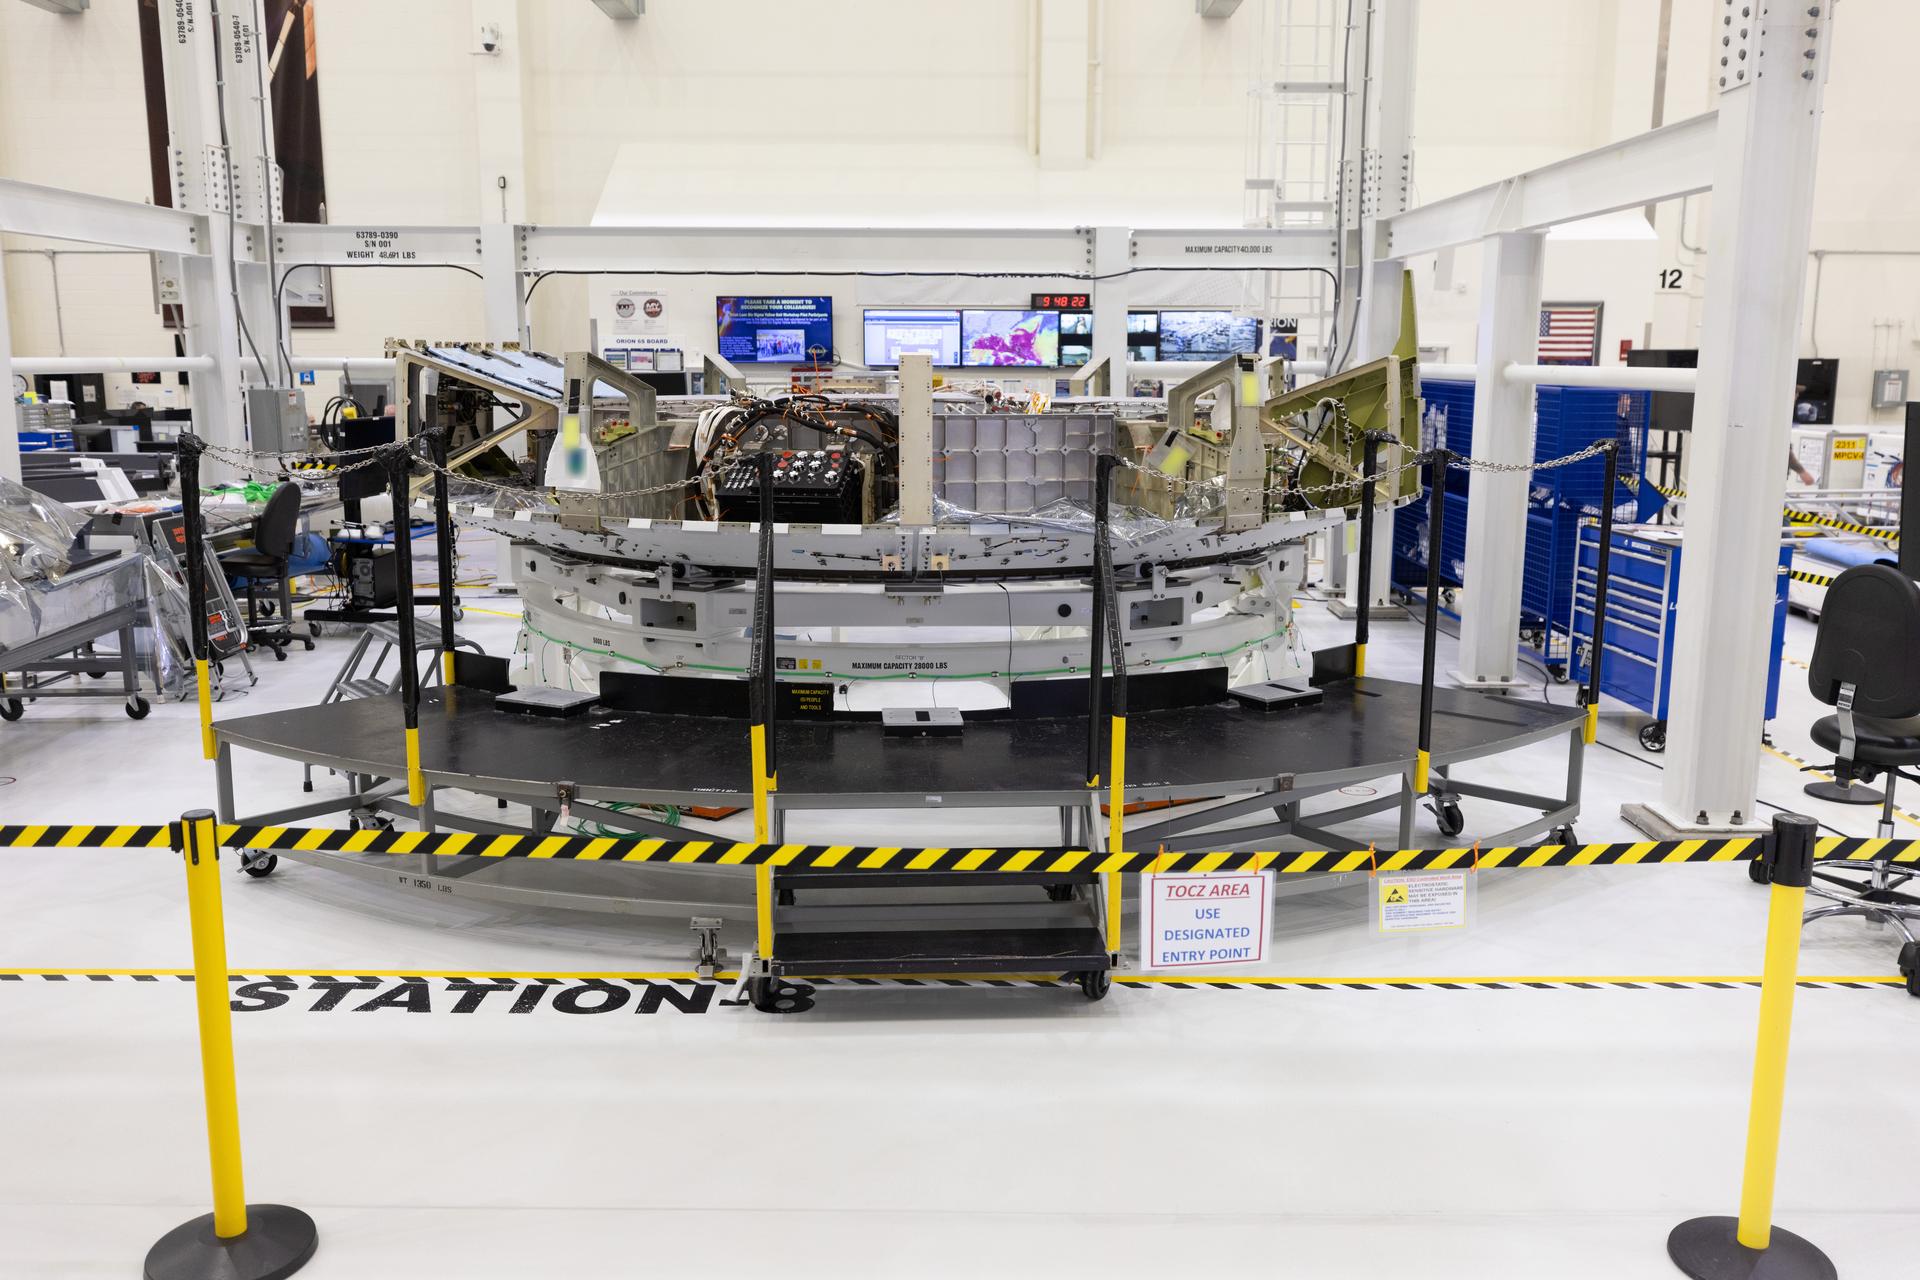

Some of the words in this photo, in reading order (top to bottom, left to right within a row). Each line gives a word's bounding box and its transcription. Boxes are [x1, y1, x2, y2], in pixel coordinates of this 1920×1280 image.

[356, 231, 399, 239] 63789-0390
[364, 240, 376, 248] S/N
[378, 240, 391, 248] 001
[1185, 245, 1212, 254] MAXIMUM
[1262, 245, 1273, 254] LBS
[346, 251, 374, 259] WEIGHT
[402, 251, 416, 259] LBS
[1659, 268, 1683, 289] 12
[1835, 441, 1857, 449] 2311
[852, 662, 882, 670] MAXIMUM
[884, 662, 913, 670] CAPACITY
[914, 662, 934, 670] 28000
[413, 879, 431, 889] 1350
[1166, 885, 1206, 898] TOCZ
[1209, 883, 1250, 896] AREA
[1195, 908, 1221, 920] USE
[1164, 926, 1250, 941] DESIGNATED
[1162, 950, 1206, 963] ENTRY
[1209, 947, 1251, 960] POINT
